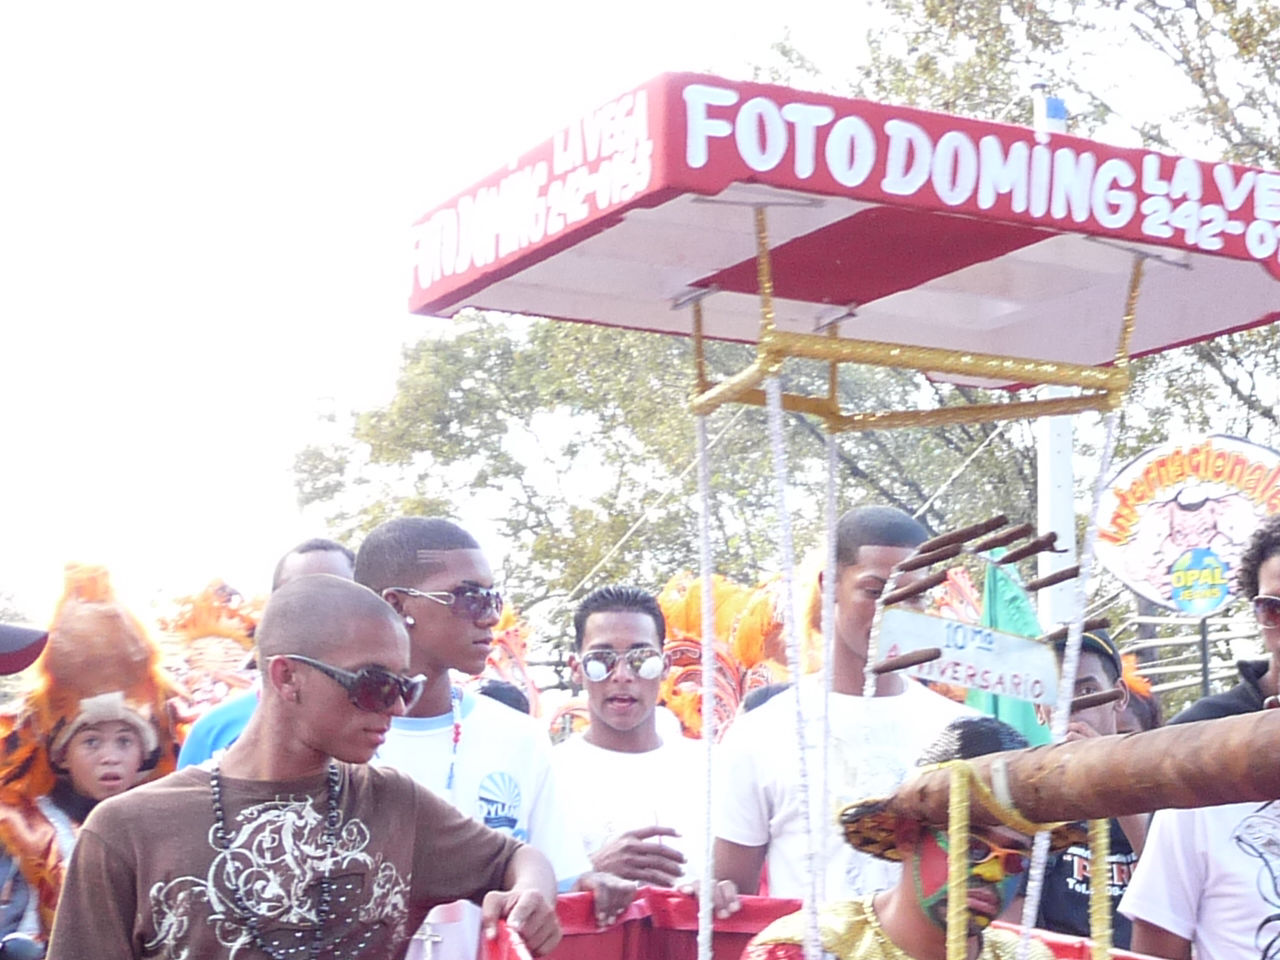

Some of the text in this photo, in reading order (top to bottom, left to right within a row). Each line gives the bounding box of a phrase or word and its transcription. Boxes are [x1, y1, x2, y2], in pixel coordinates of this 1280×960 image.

[683, 84, 877, 188] FOTO
[1141, 153, 1203, 201] LA
[1171, 566, 1229, 588] OPAL
